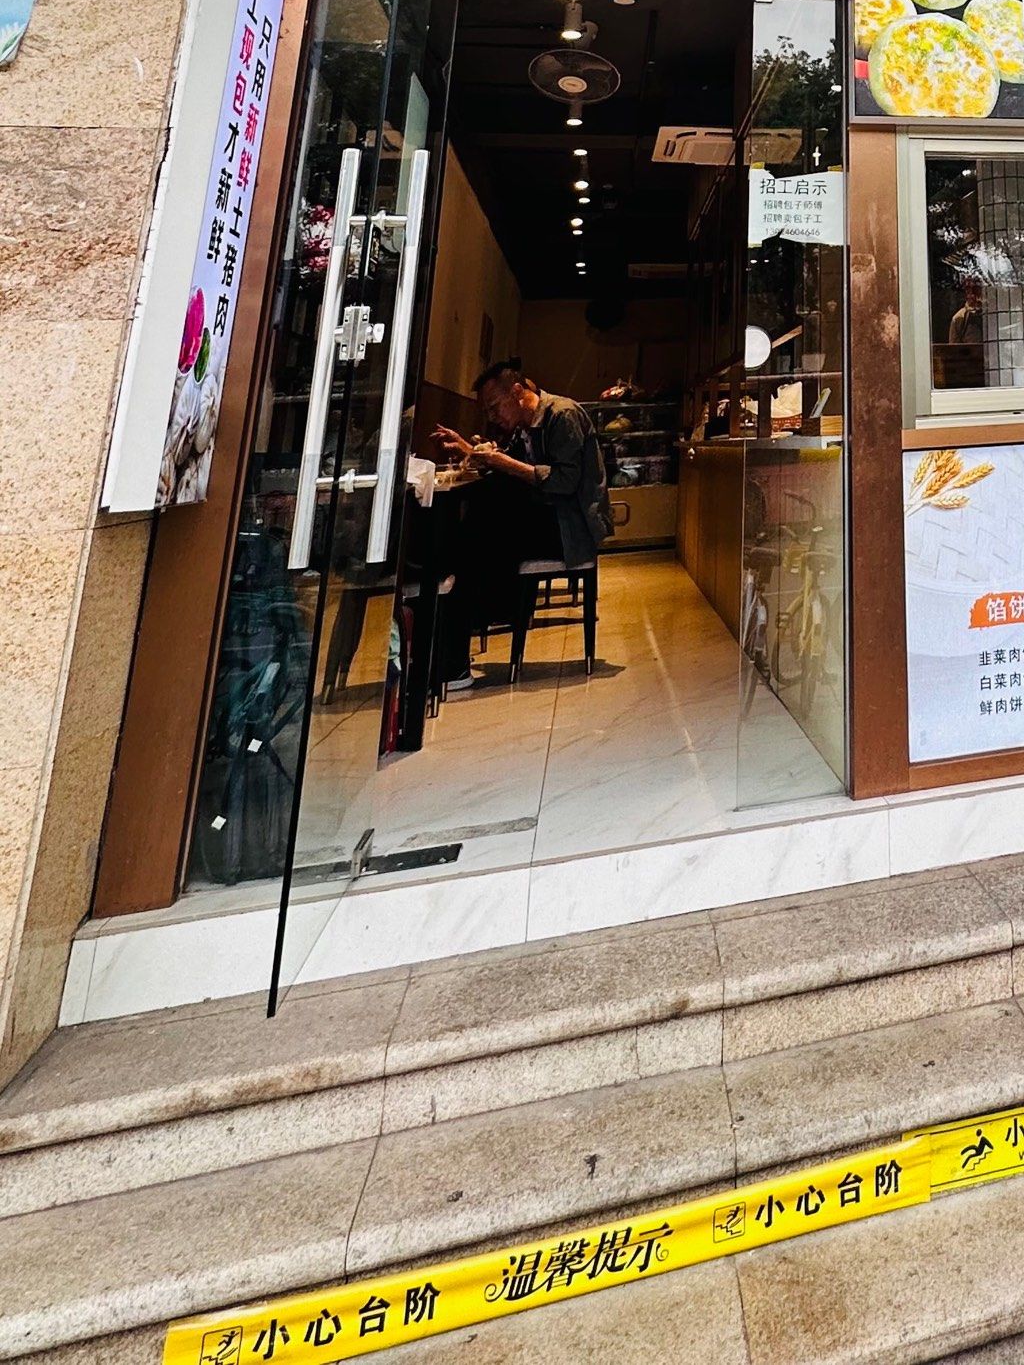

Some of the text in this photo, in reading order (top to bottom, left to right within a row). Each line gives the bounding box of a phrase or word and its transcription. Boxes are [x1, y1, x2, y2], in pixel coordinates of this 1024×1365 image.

[213, 15, 273, 338] 只用新鲜土猪肉
[760, 179, 827, 196] 招工启示
[980, 696, 1023, 715] 鲜肉饼
[755, 1160, 902, 1228] 小心台阶
[484, 1223, 675, 1303] 温馨提示
[252, 1282, 441, 1360] 小心台阶
